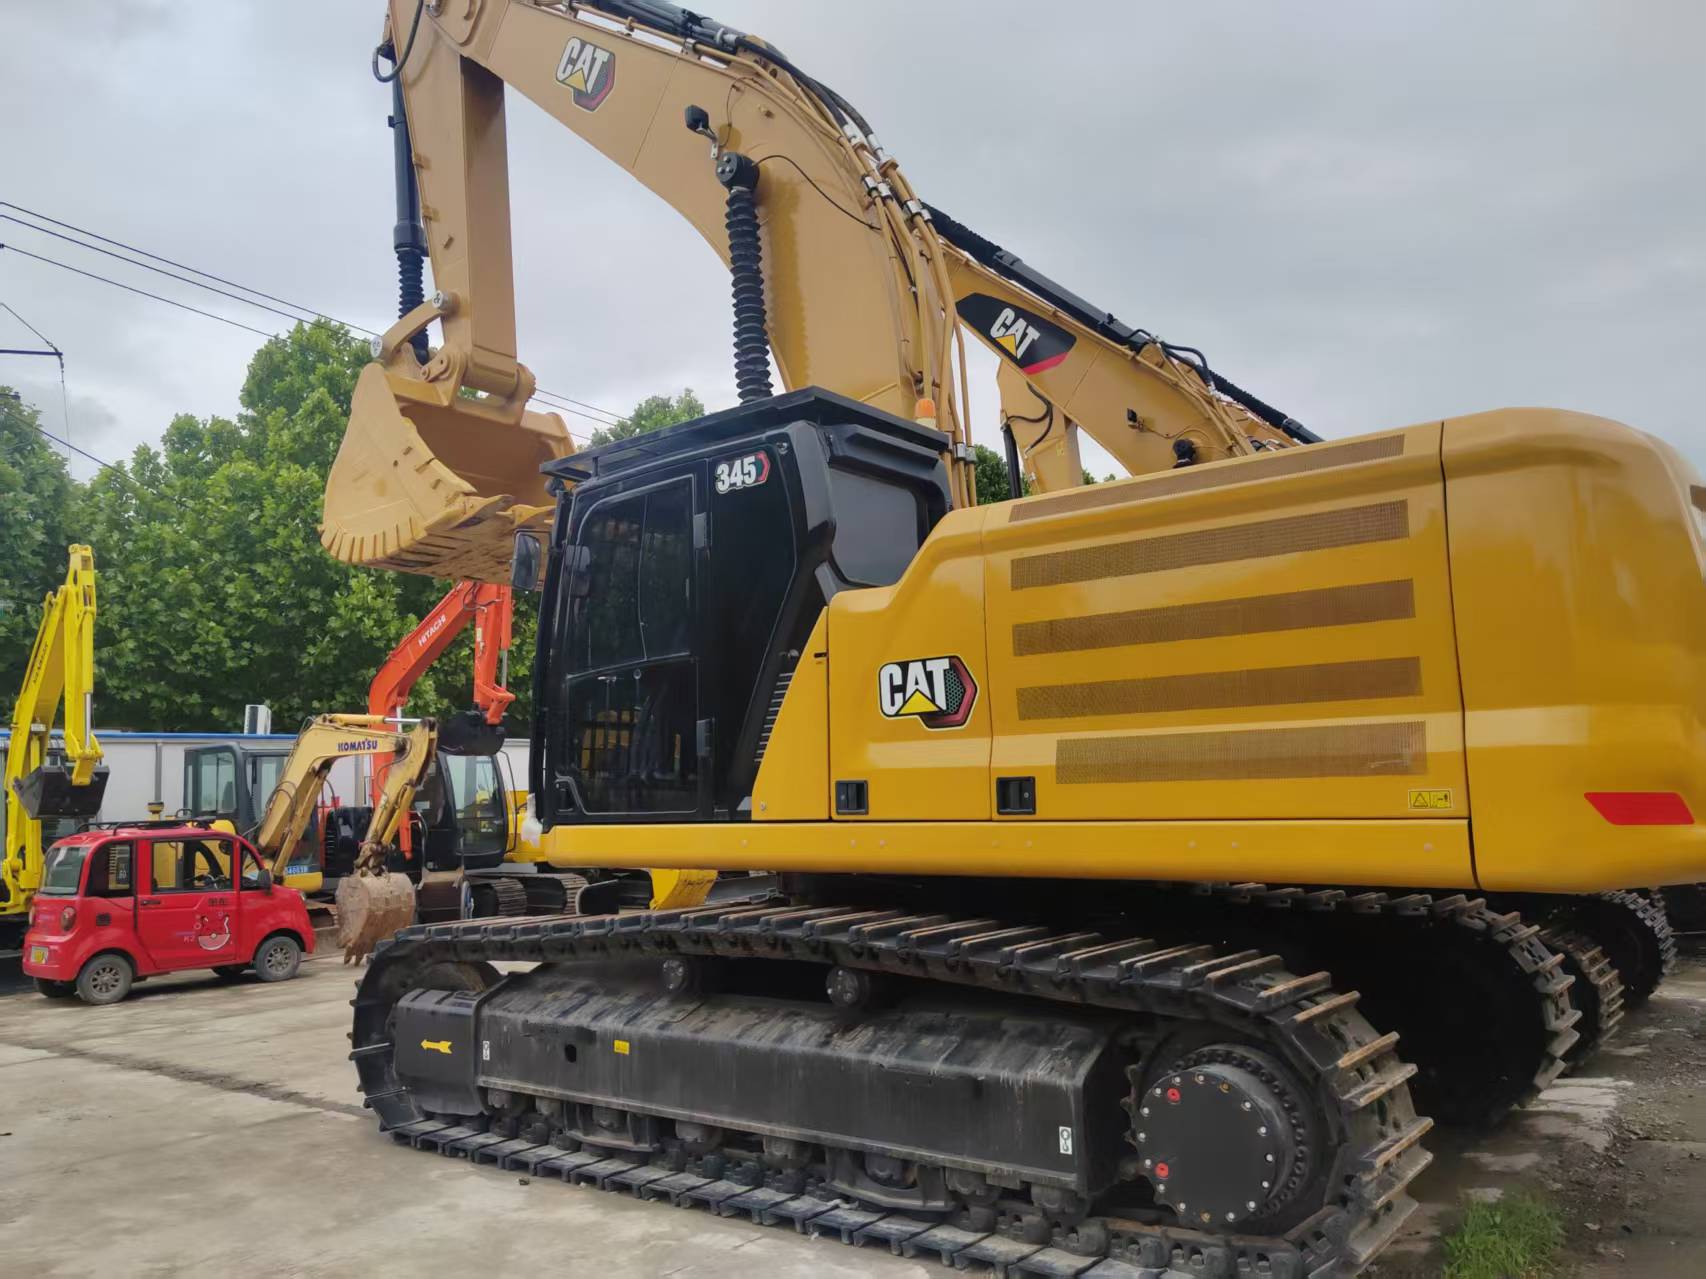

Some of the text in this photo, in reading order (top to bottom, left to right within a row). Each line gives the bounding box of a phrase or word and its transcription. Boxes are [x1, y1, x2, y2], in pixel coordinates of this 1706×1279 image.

[557, 37, 610, 94] CAT
[990, 307, 1041, 360] CAT
[716, 455, 757, 491] 345
[880, 658, 950, 716] CAT
[336, 740, 378, 752] KOMATSU
